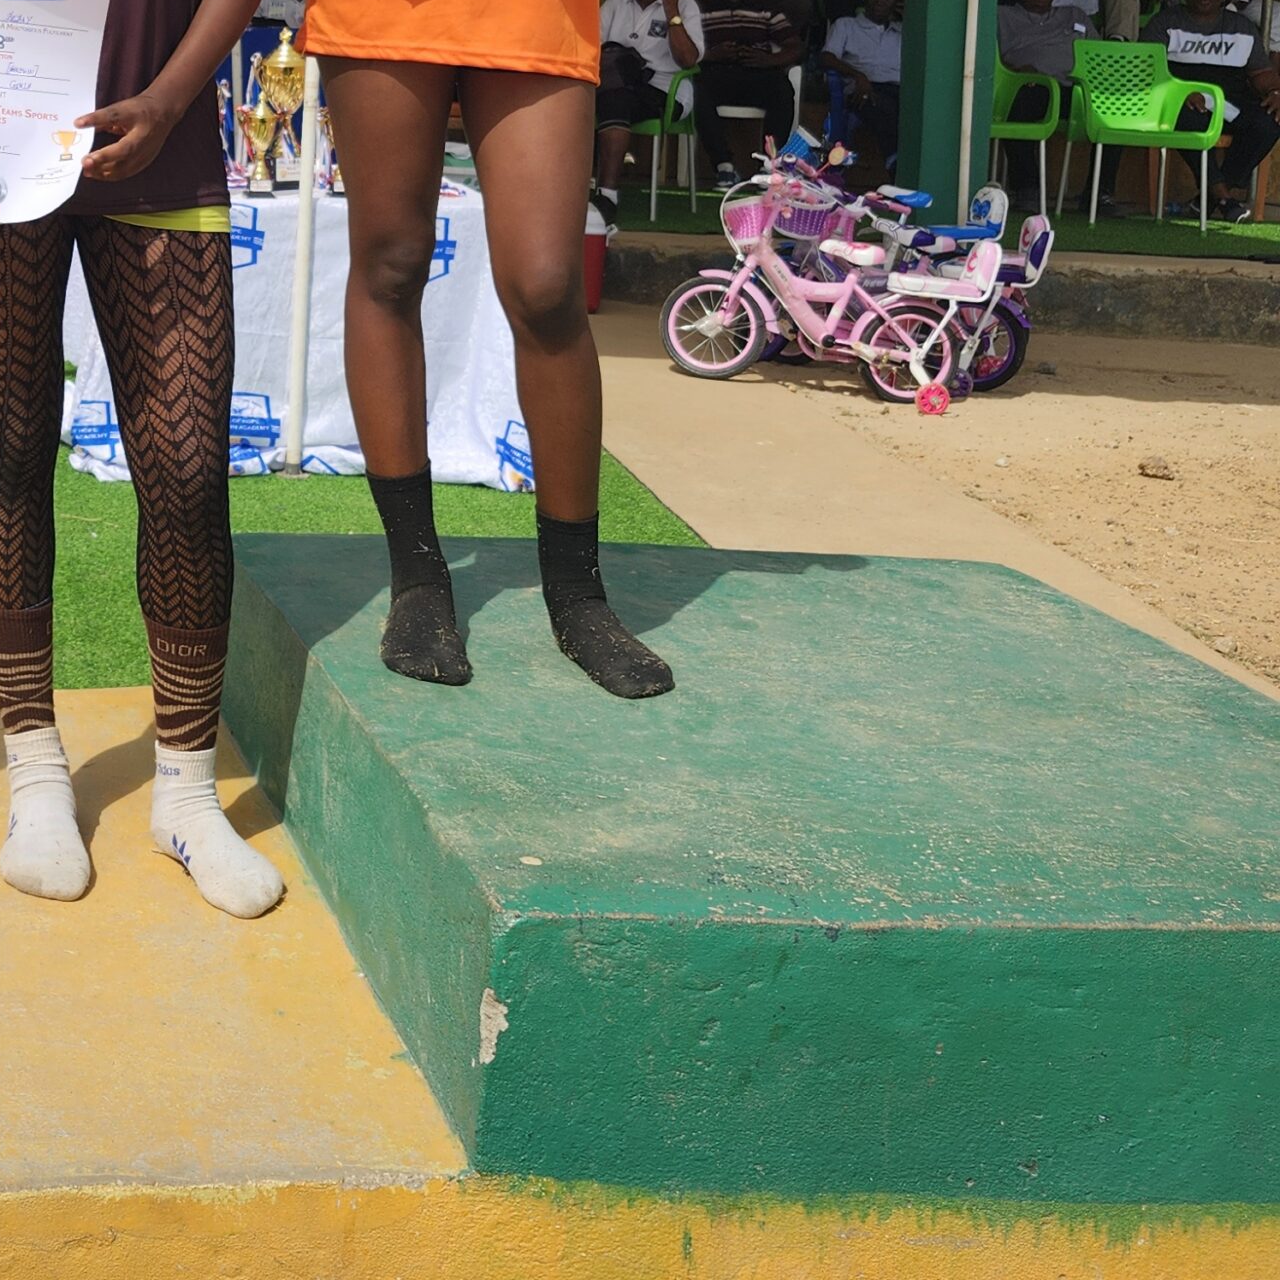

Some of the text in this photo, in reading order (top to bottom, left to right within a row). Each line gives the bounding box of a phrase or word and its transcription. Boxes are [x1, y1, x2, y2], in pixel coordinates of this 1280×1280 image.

[1180, 40, 1235, 56] DKNY
[24, 109, 59, 121] SPORTS
[155, 637, 208, 657] DIOR
